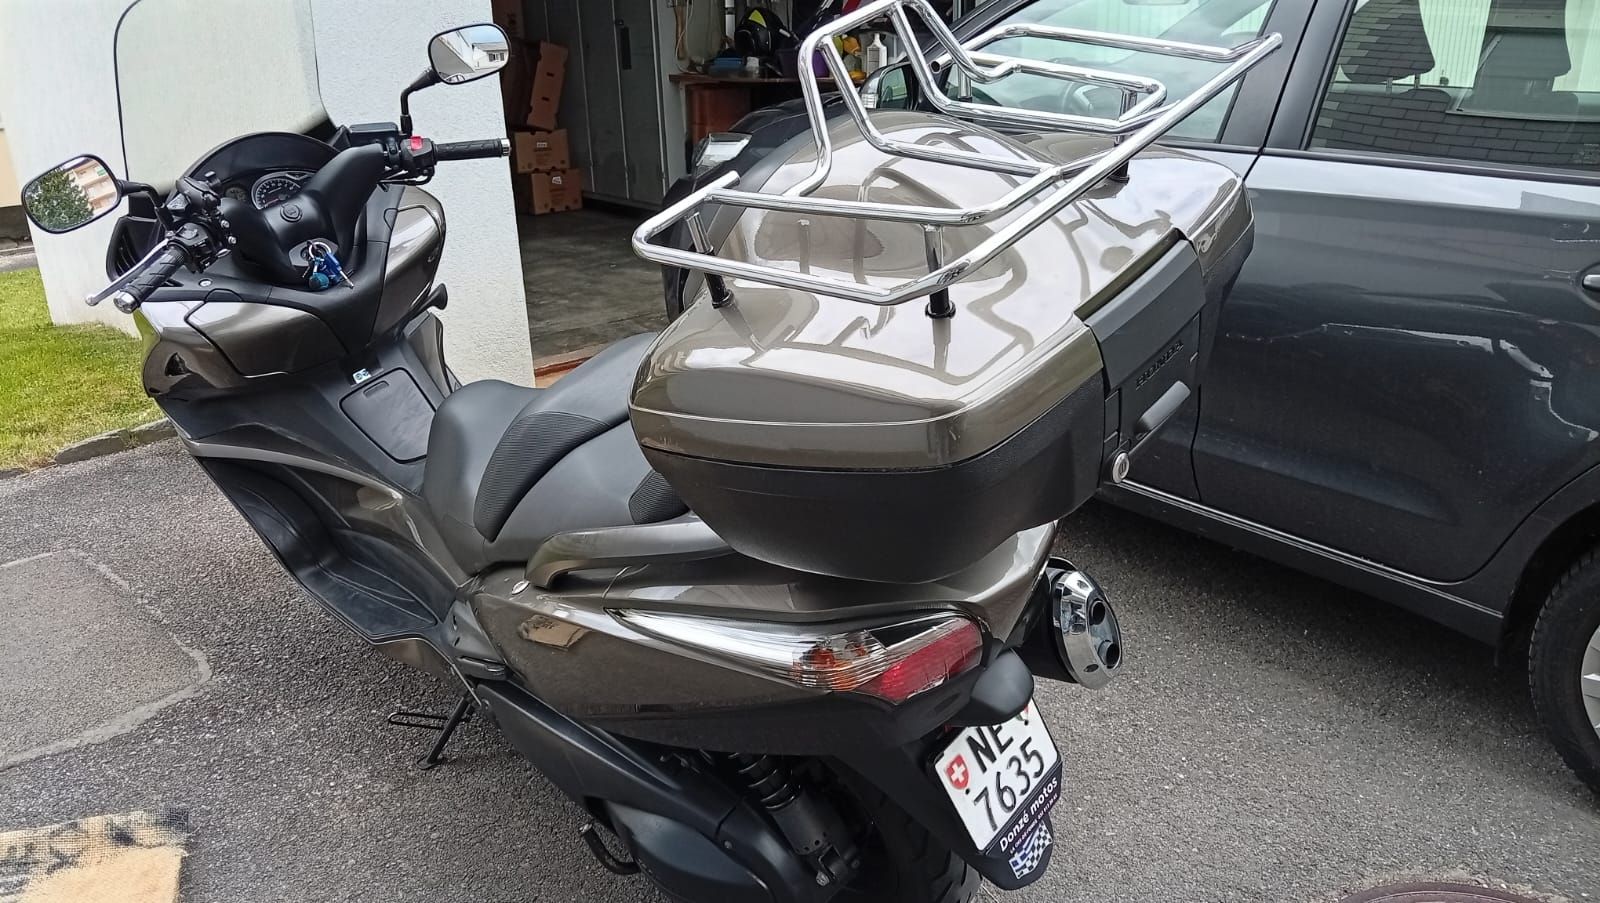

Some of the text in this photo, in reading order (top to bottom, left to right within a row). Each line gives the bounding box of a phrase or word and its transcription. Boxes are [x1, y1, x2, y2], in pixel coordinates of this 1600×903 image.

[967, 725, 1014, 773] NE
[973, 737, 1044, 832] 7635
[999, 812, 1030, 852] Donzé
[1030, 777, 1058, 815] motos
